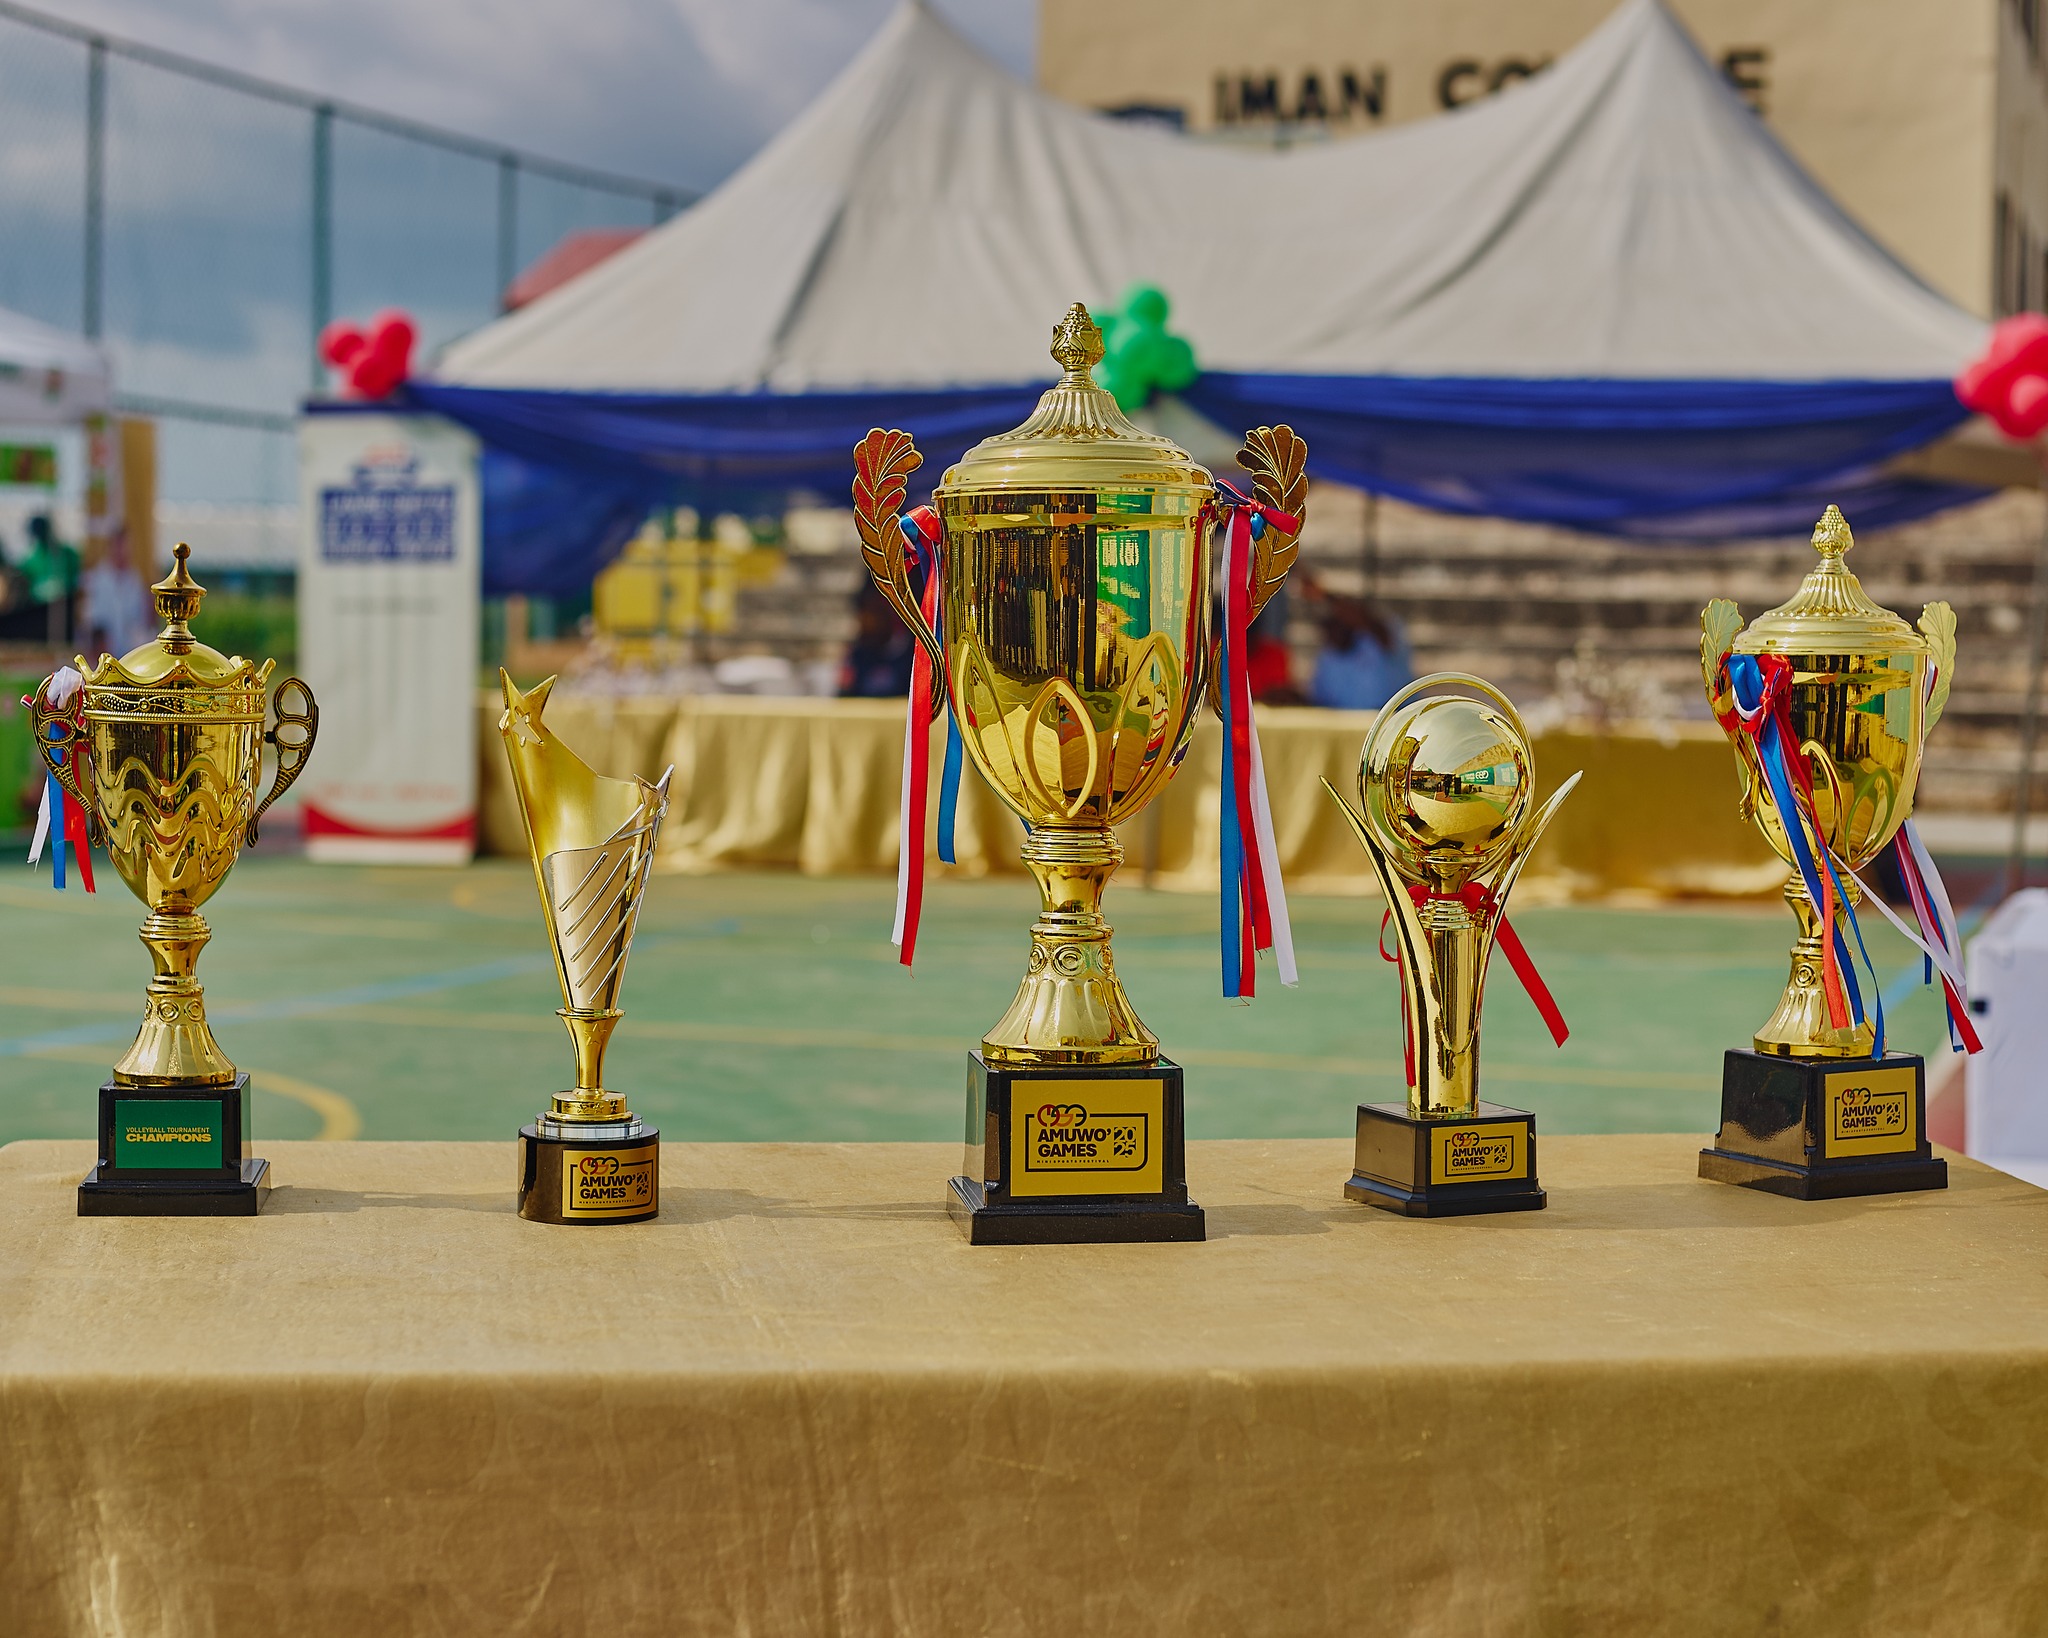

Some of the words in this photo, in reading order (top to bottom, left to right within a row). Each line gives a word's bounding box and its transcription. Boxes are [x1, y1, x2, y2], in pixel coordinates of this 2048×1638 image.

[1213, 65, 1387, 125] IMAN
[1842, 1116, 1878, 1129] GAMES
[125, 1133, 212, 1142] CHAMPIONS
[1037, 1143, 1097, 1157] GAMES
[1452, 1156, 1486, 1167] GAMES
[580, 1187, 627, 1199] GAMES
